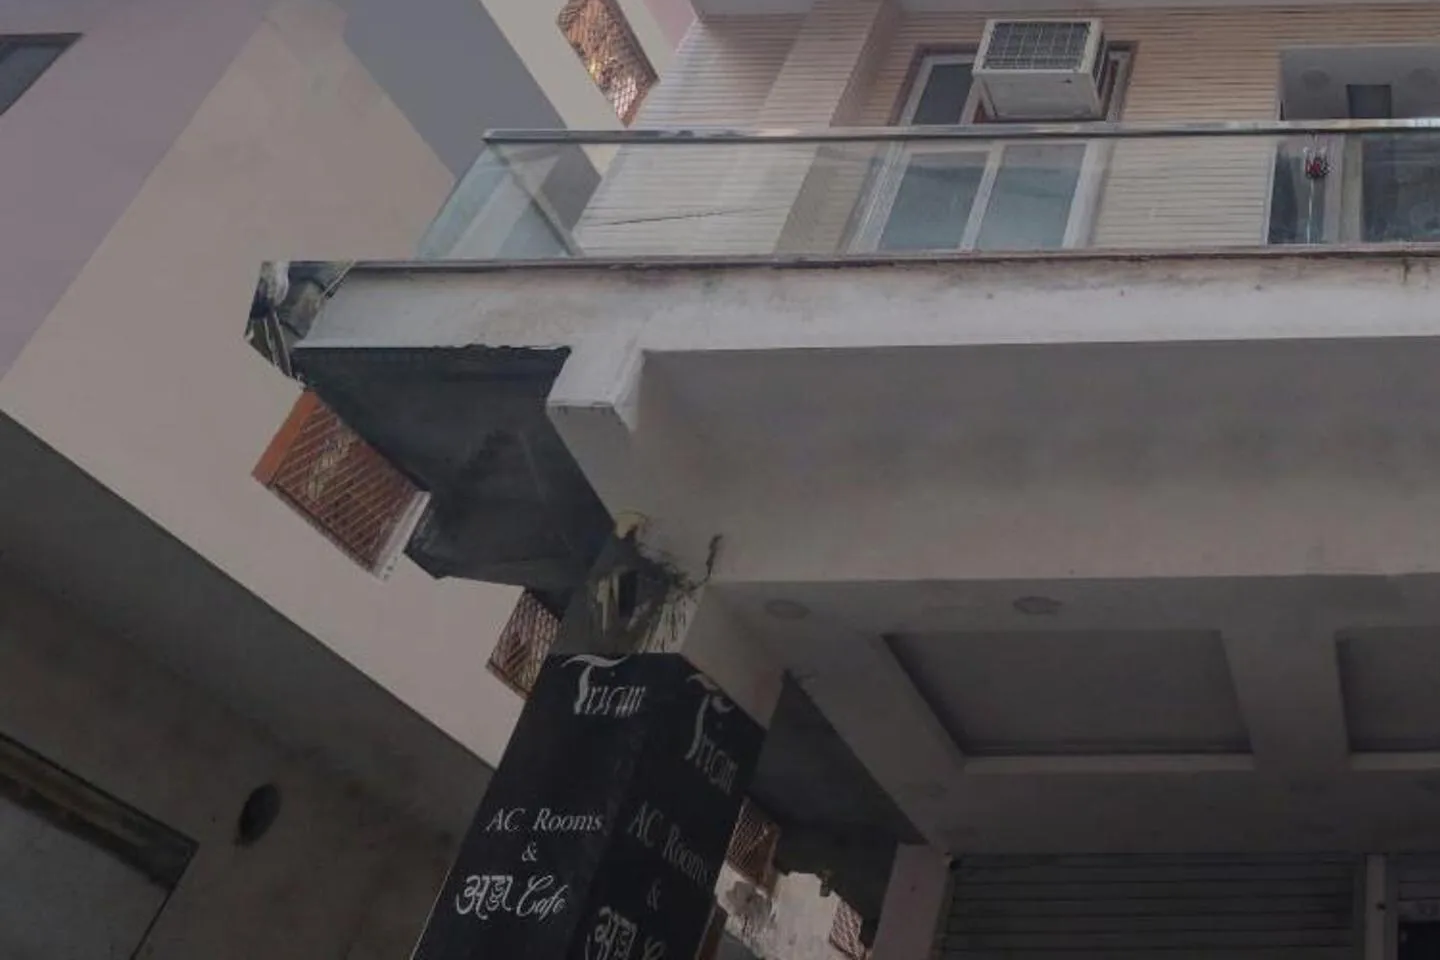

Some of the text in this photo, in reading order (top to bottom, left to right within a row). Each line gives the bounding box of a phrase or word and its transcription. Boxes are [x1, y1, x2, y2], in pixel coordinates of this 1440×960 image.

[484, 807, 604, 833] AC Rooms
[627, 801, 664, 848] AC
[521, 841, 538, 863] &
[516, 874, 569, 921] Cafe
